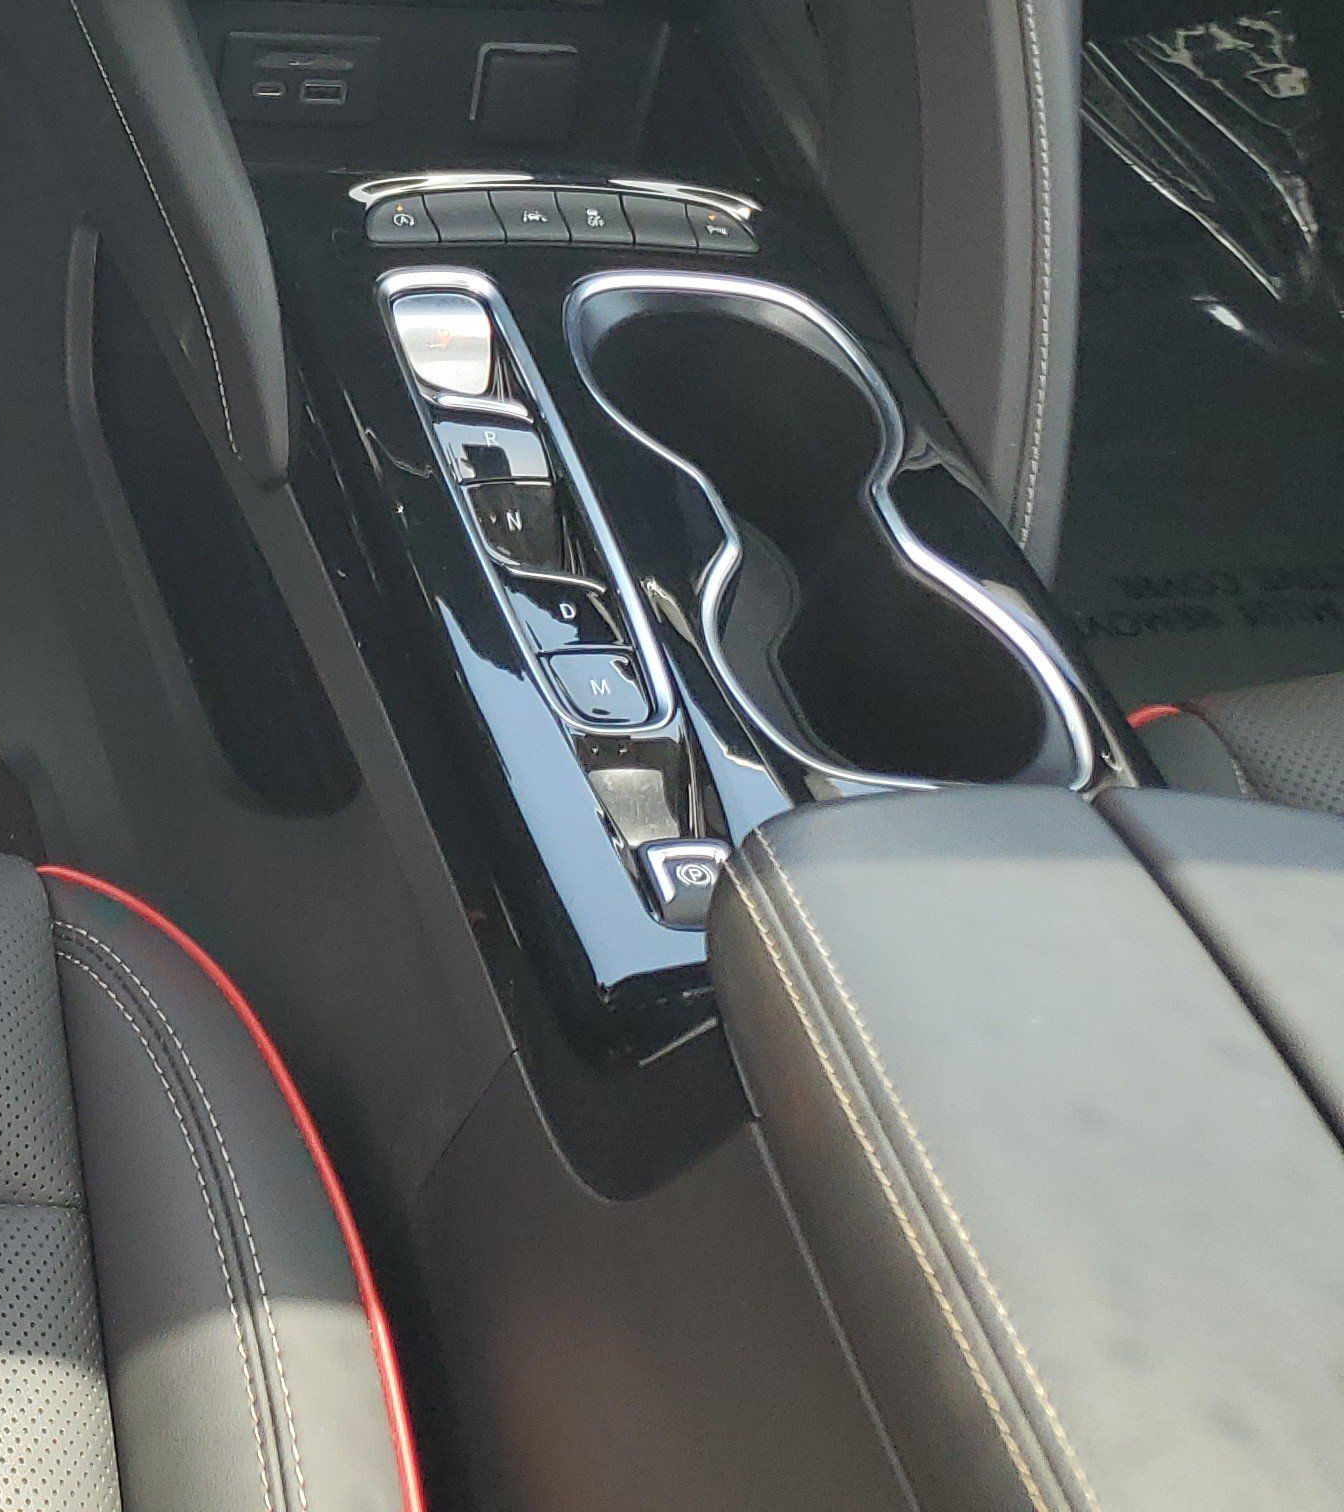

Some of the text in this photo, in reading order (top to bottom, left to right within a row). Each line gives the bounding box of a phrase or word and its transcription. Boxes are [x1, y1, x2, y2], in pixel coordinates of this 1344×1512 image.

[484, 430, 499, 448] R
[505, 510, 524, 531] N
[560, 602, 576, 621] D
[590, 679, 612, 695] M
